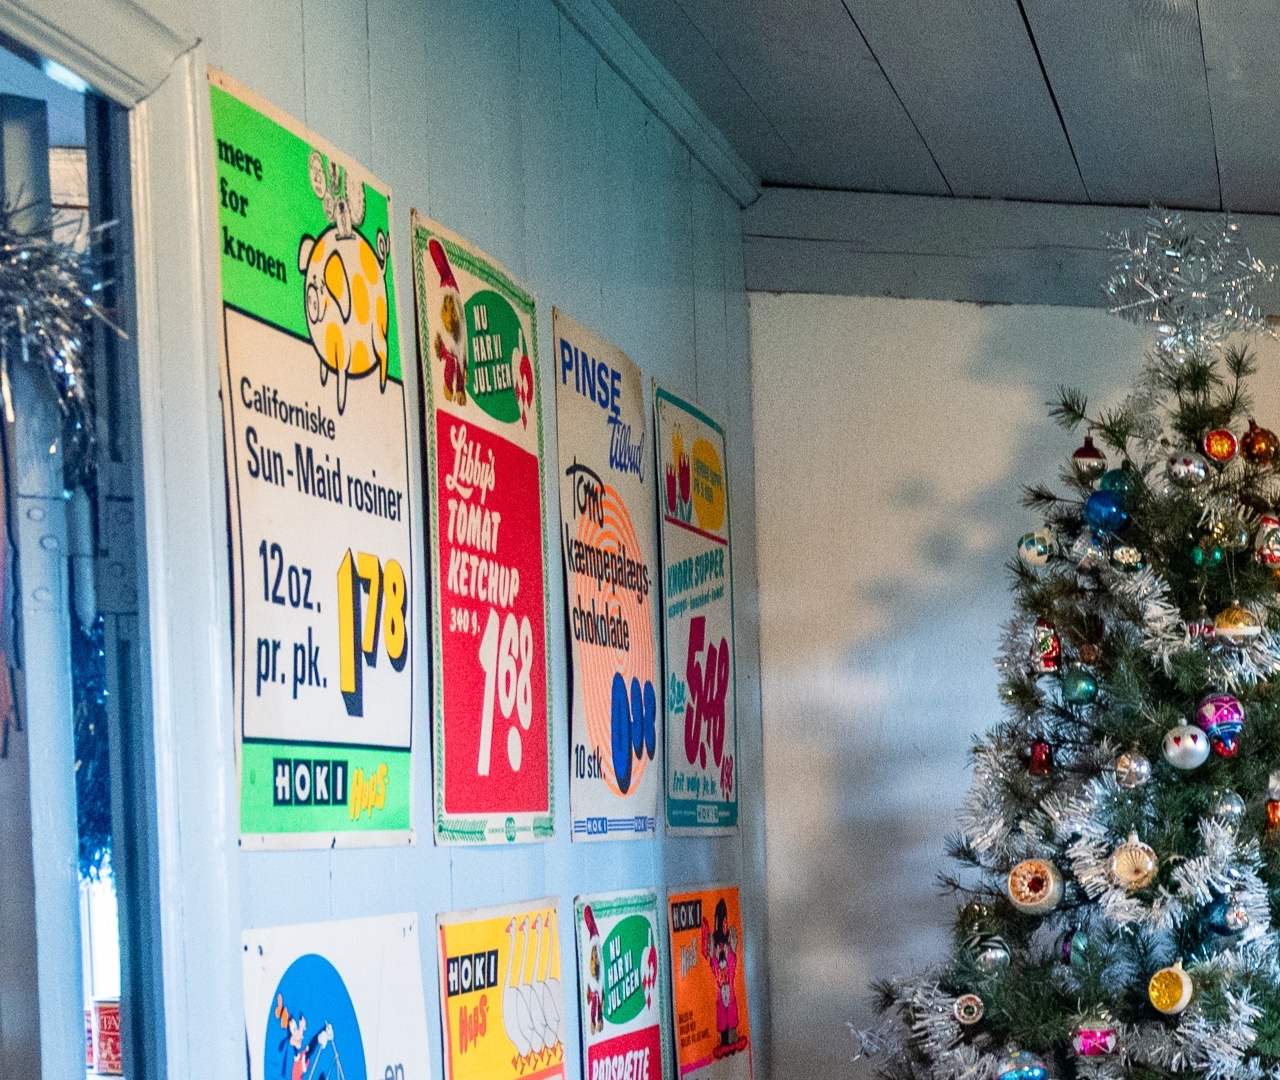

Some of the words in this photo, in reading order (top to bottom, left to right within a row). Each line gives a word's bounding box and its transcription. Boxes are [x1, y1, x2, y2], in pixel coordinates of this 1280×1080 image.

[217, 137, 263, 182] mere
[219, 176, 248, 218] for
[222, 226, 288, 284] kronen
[473, 305, 488, 332] NU
[472, 334, 493, 362] HAR
[493, 334, 502, 359] VI
[472, 367, 493, 395] JUL
[493, 363, 514, 390] IGEN
[560, 337, 622, 416] PINSE
[240, 375, 336, 441] Californiske
[445, 424, 496, 503] Libby's
[607, 412, 645, 484] Tilbud
[245, 426, 344, 506] Sun-Maid
[346, 470, 403, 523] rosiner
[565, 455, 606, 528] Toms
[447, 498, 501, 555] TOMAT
[448, 548, 520, 609] KETCHUP
[573, 595, 630, 652] chokolade
[256, 636, 286, 697] pr.
[292, 626, 328, 700] pk.
[273, 759, 348, 806] HOKI
[575, 743, 586, 779] 10
[587, 744, 607, 780] stk.
[672, 899, 703, 933] HOKI
[447, 948, 499, 998] HOKI
[609, 934, 621, 963] NU
[607, 962, 624, 989] HAR
[607, 988, 622, 1018] JUL
